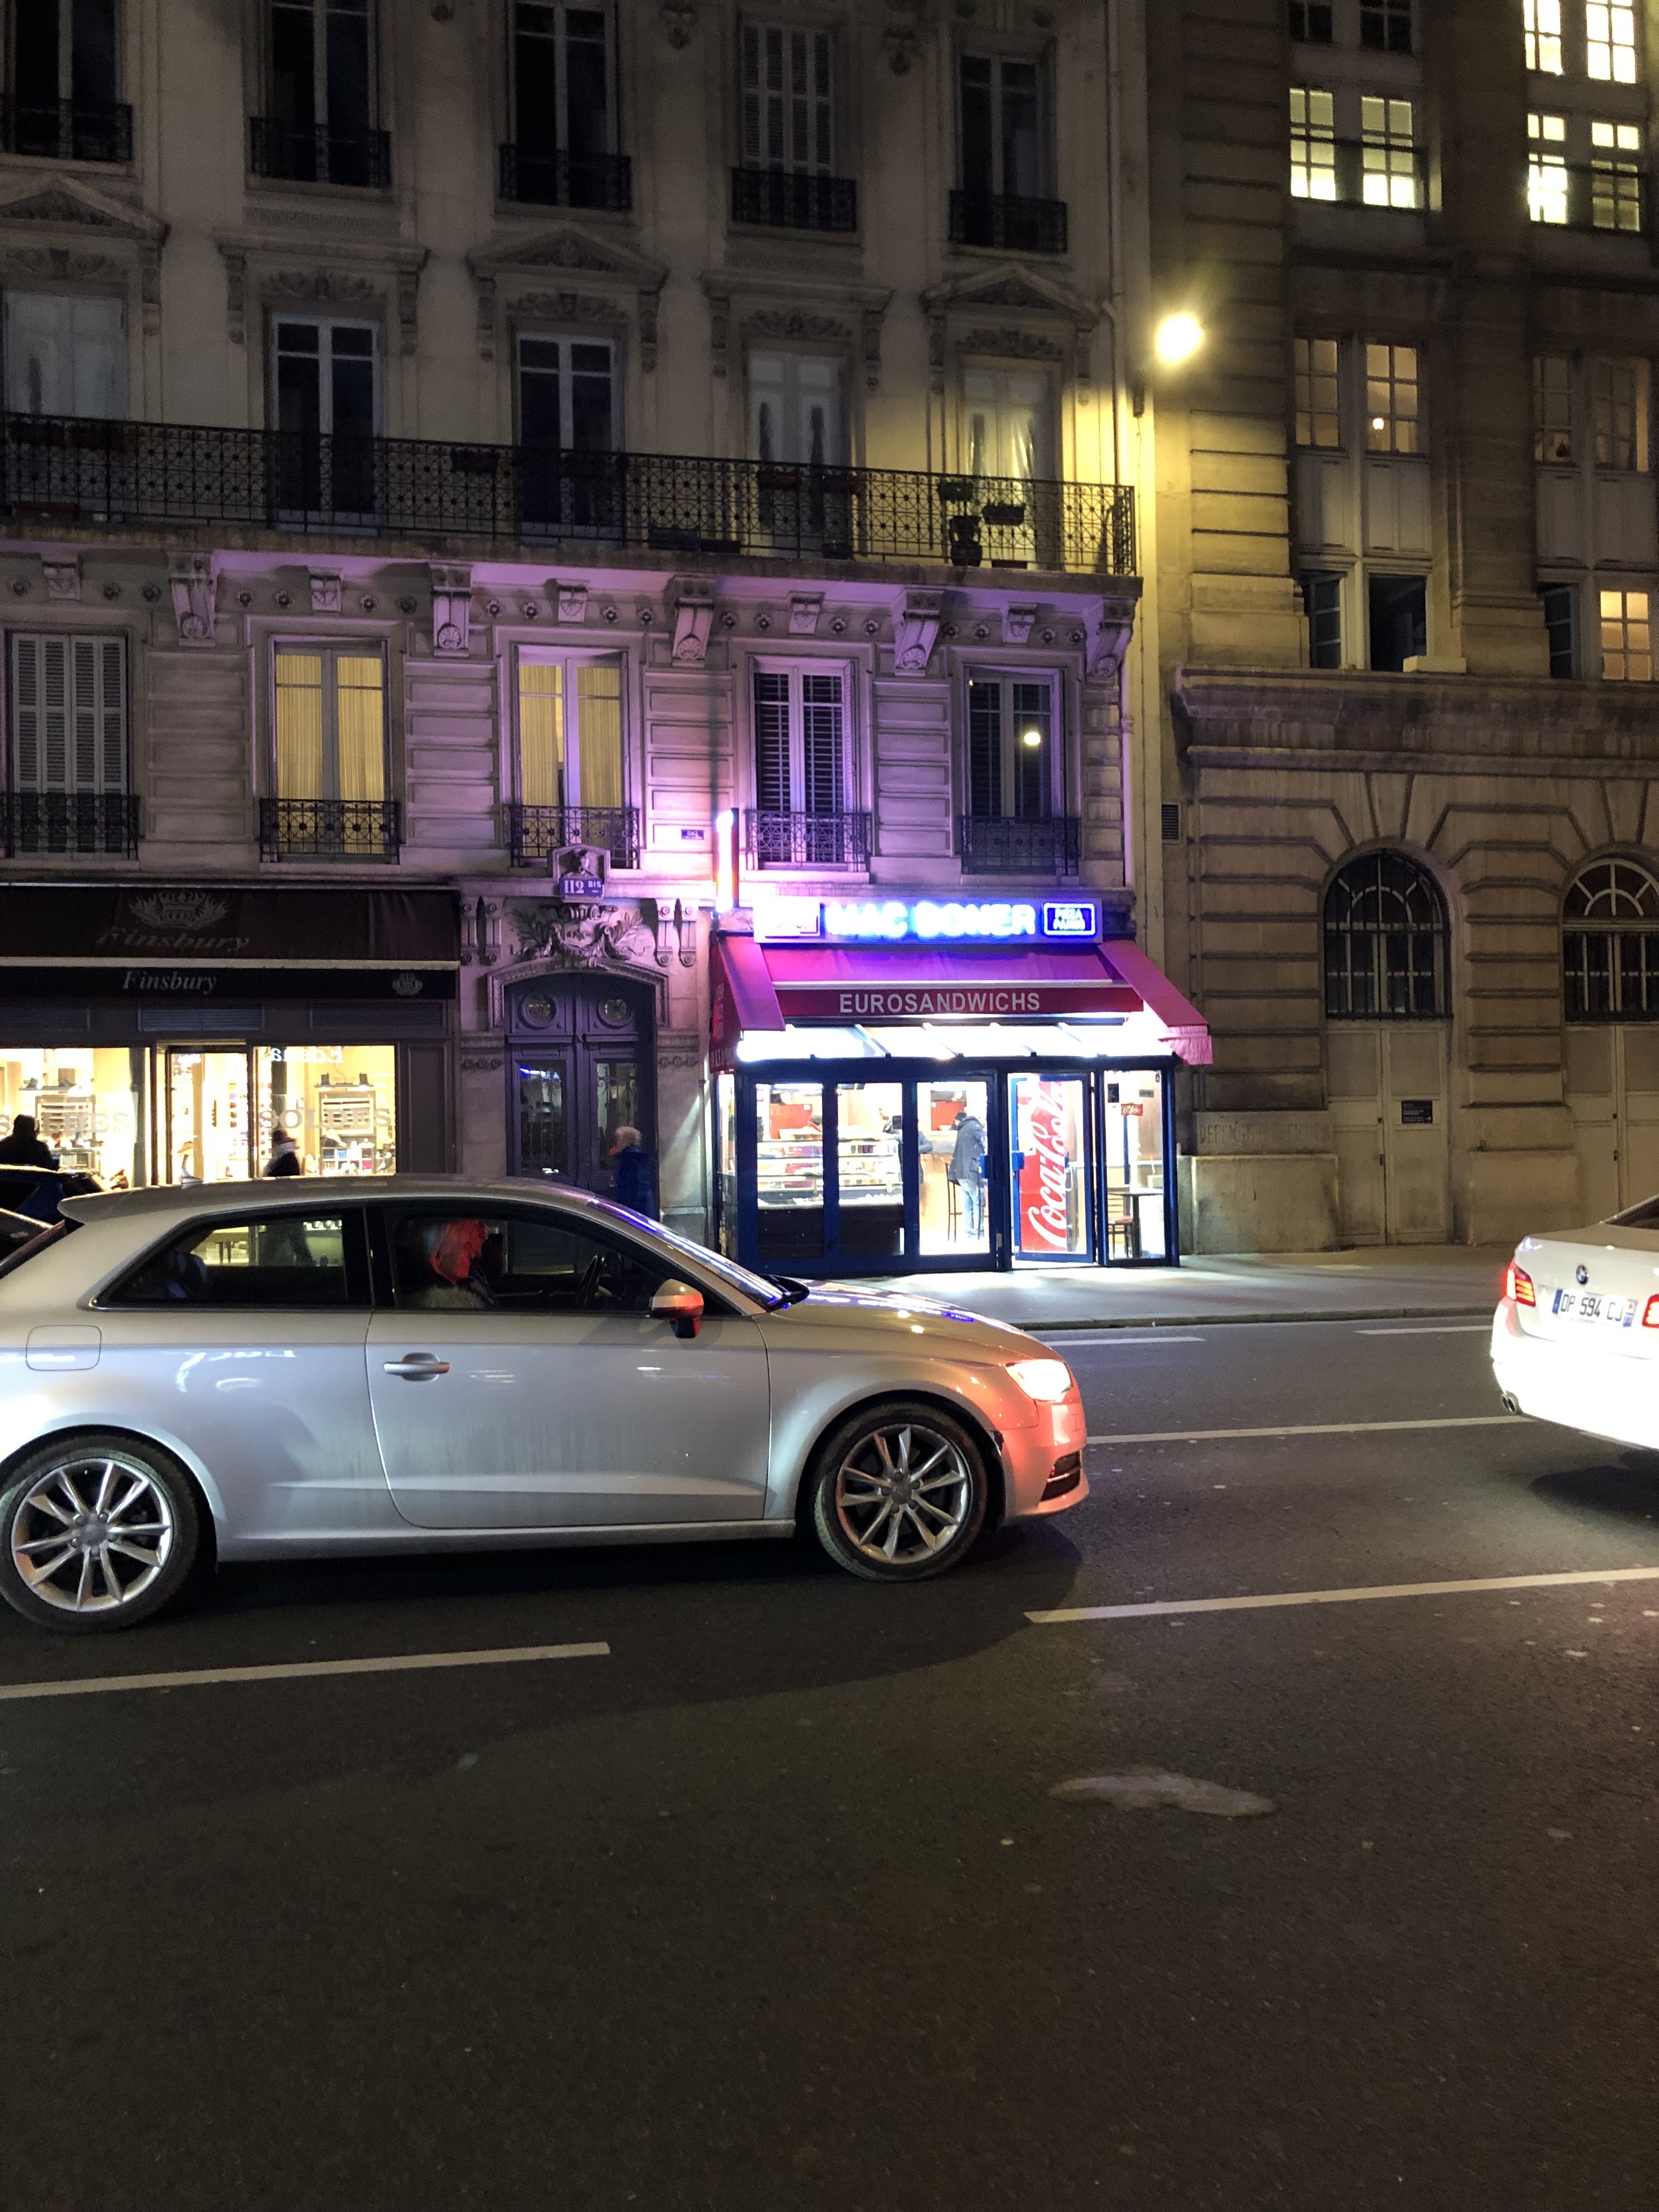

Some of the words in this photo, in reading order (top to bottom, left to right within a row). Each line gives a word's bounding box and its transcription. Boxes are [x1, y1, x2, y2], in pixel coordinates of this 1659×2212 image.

[564, 880, 584, 894] 112
[95, 926, 250, 952] Finsbury
[122, 970, 218, 995] Finsbury
[839, 992, 1040, 1013] EUROSANDWICHS
[259, 1108, 392, 1130] SOLDES
